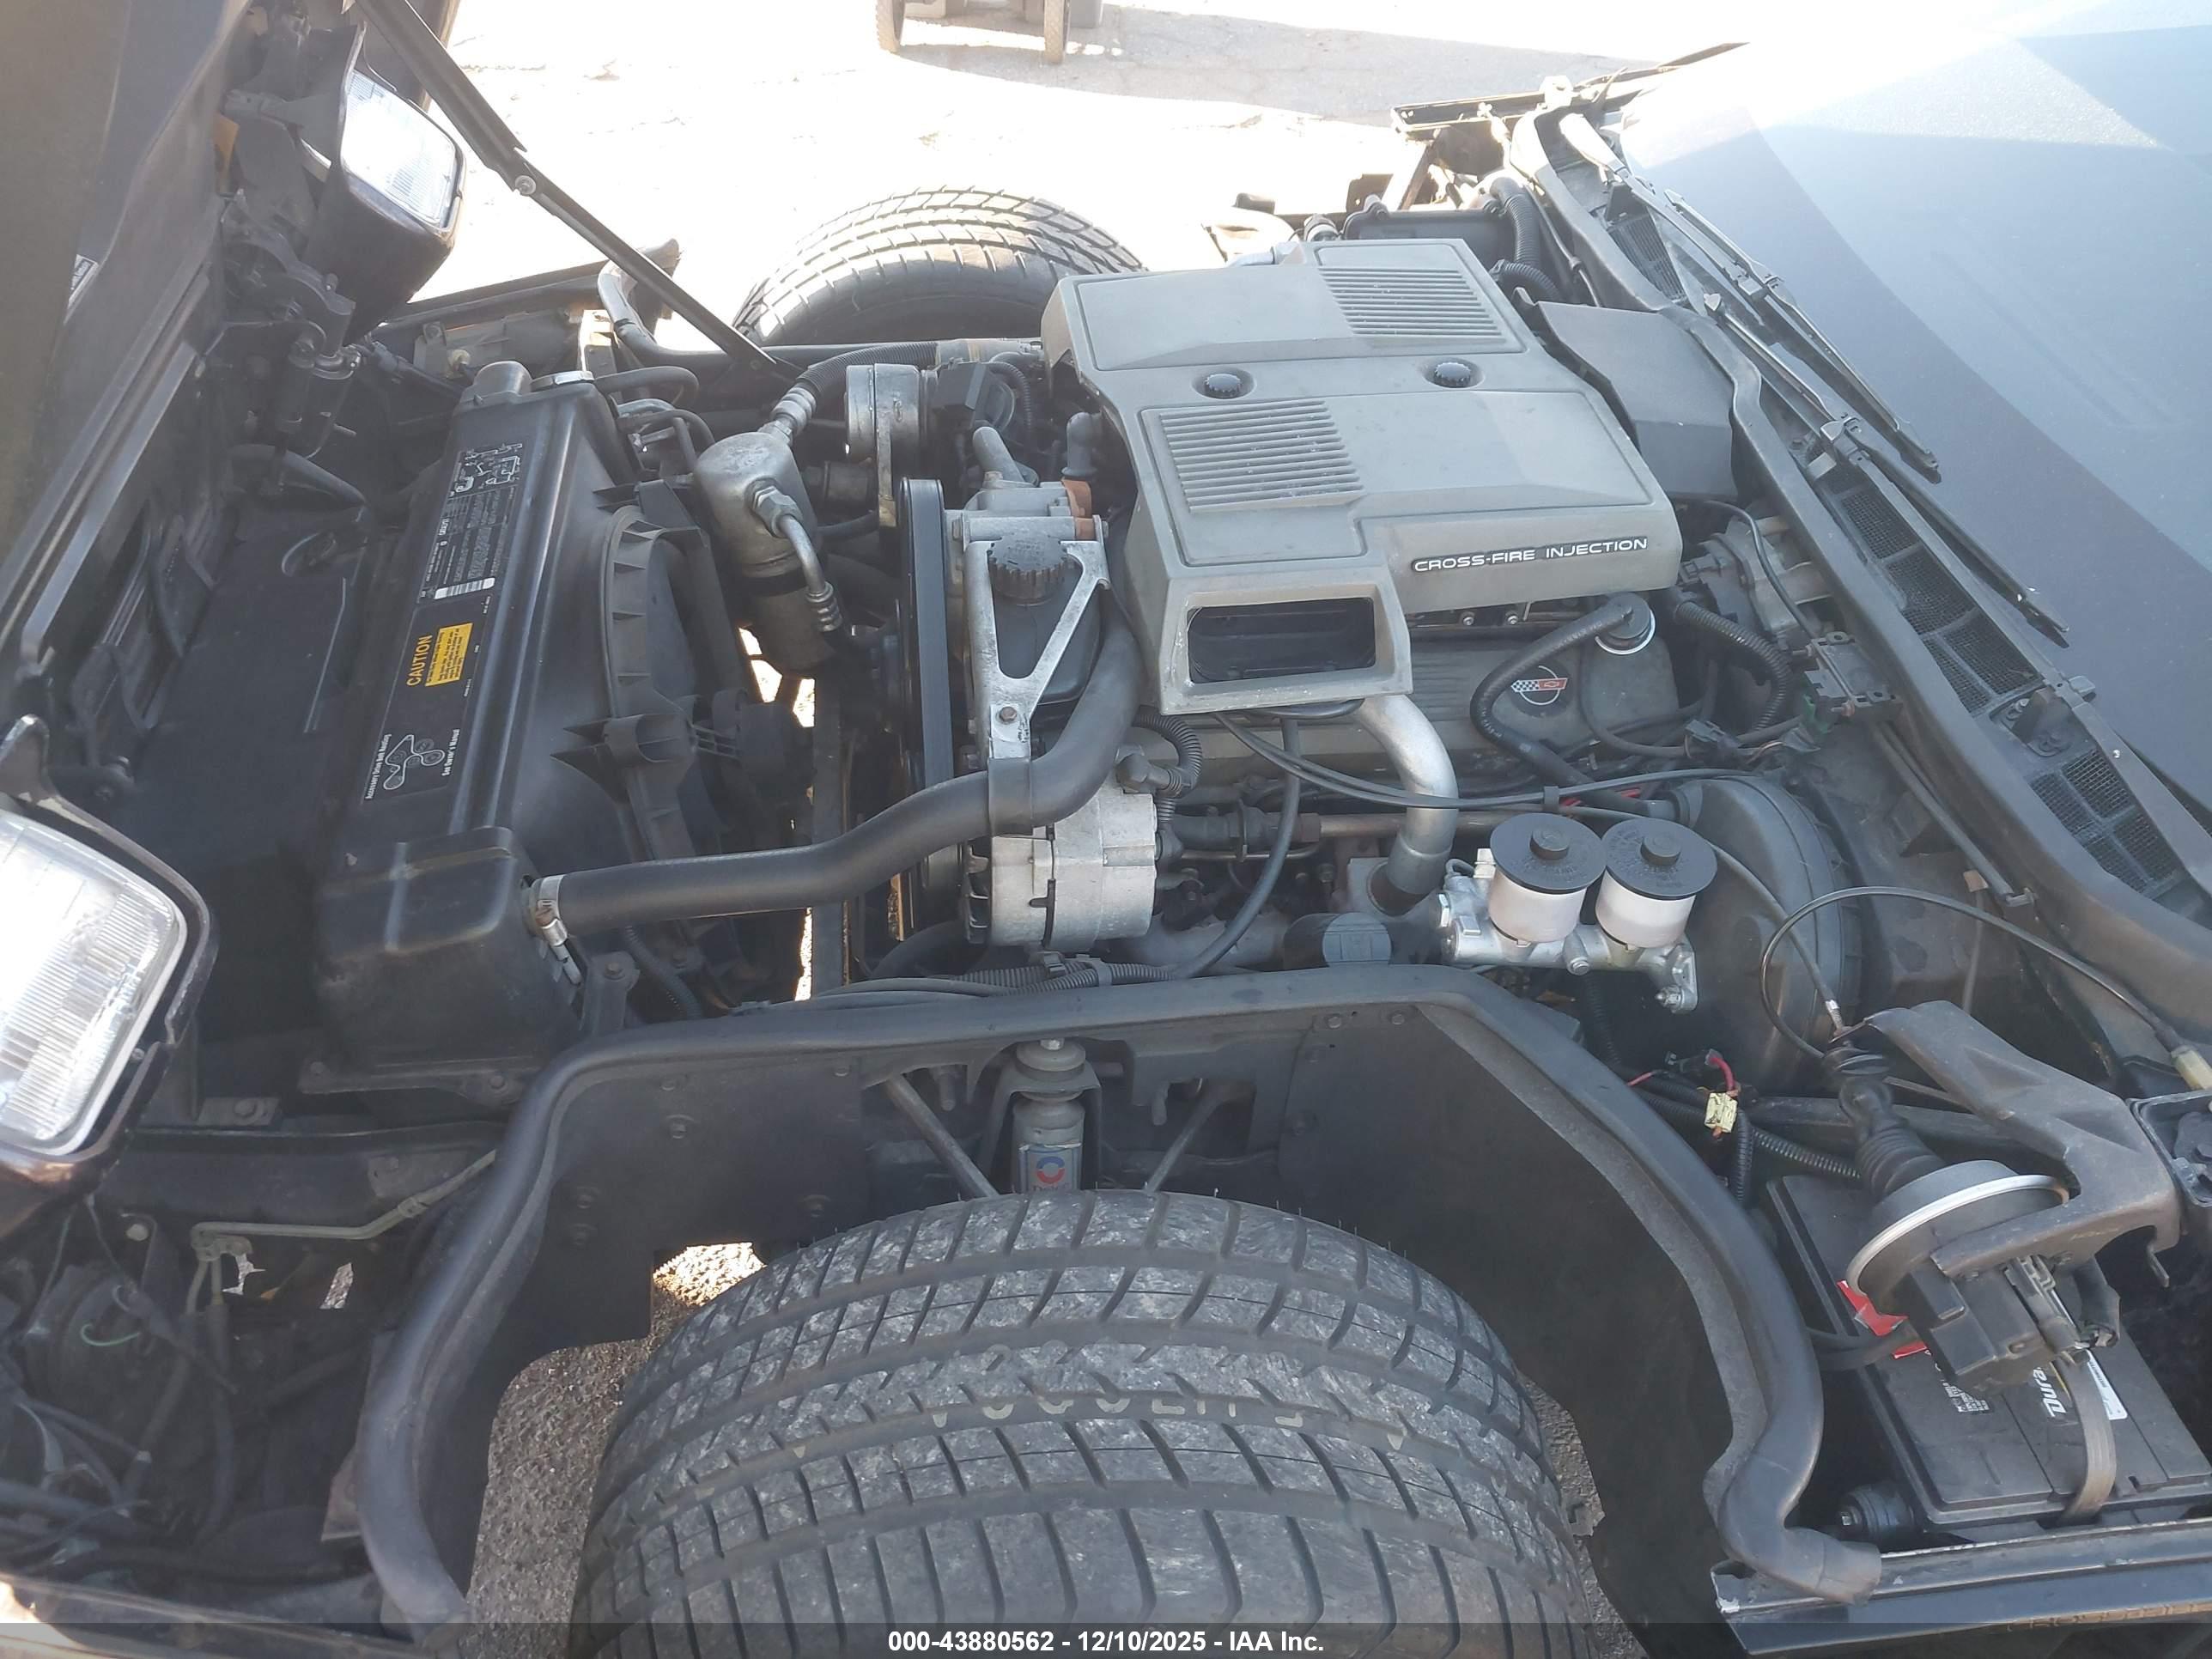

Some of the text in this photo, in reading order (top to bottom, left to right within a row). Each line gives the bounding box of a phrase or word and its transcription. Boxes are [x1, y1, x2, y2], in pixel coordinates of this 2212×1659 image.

[1414, 538, 1649, 572] CROSS-FIRE INJECTION
[406, 634, 433, 687] CAUTION
